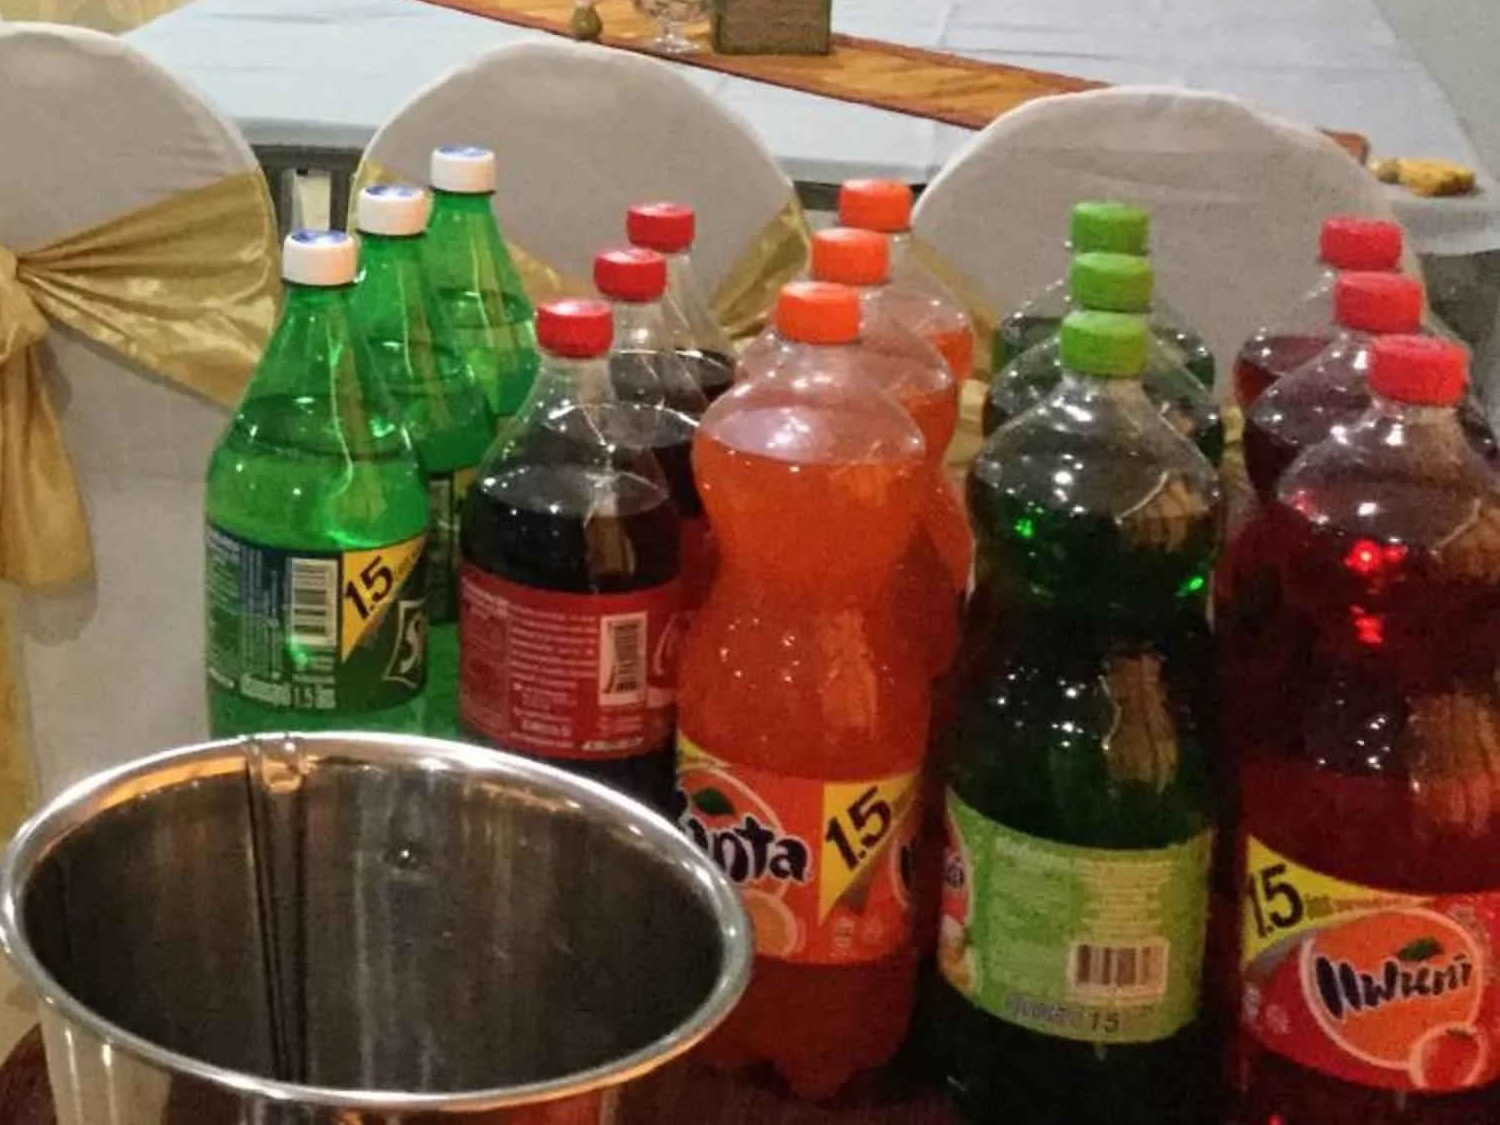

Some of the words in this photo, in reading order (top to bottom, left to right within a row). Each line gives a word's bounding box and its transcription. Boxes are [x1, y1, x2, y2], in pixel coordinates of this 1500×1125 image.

[345, 555, 393, 620] 1.5
[675, 789, 808, 883] nta
[826, 786, 892, 871] 1.5
[1249, 862, 1305, 938] 1.5
